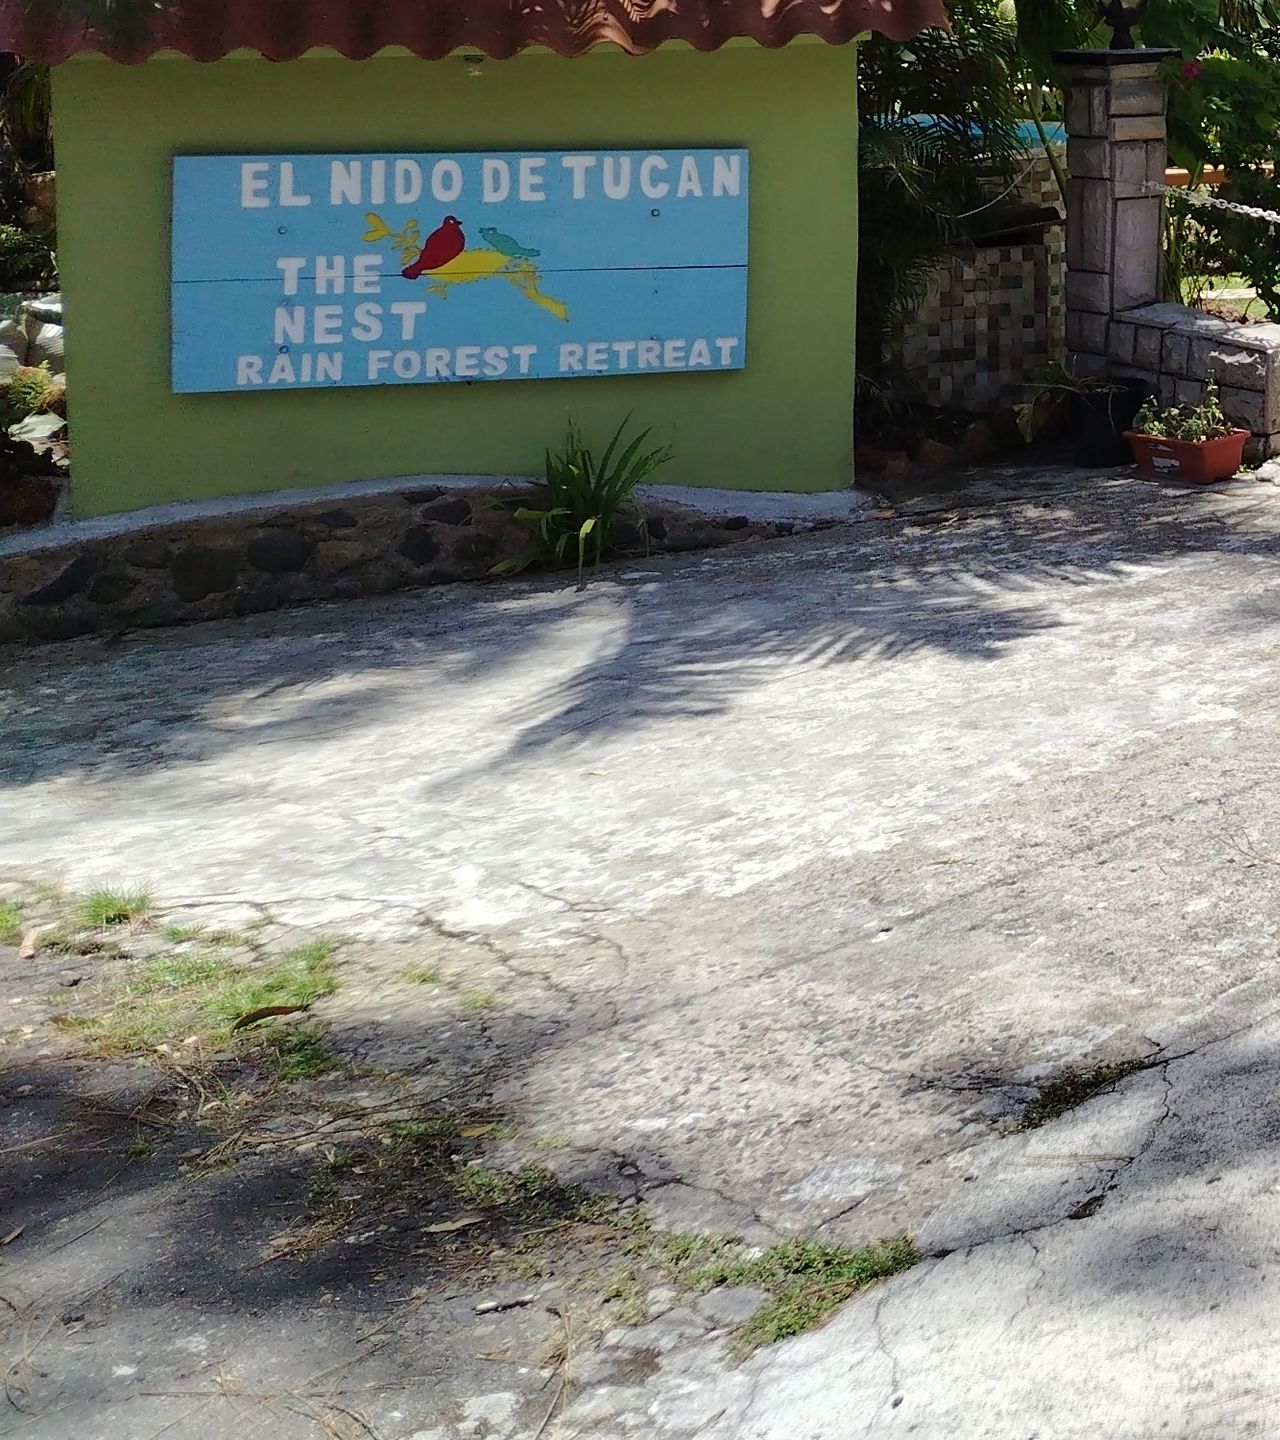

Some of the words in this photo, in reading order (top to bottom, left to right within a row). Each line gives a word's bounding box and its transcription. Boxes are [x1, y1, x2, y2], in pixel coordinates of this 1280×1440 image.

[240, 162, 311, 209] EL
[330, 158, 463, 207] NIDO
[481, 156, 547, 203] DE
[561, 154, 742, 200] TUCAN
[276, 254, 384, 295] THE
[273, 301, 427, 345] NEST
[236, 350, 344, 387] RAIN
[367, 343, 538, 381] FOREST
[559, 336, 739, 373] RETREAT
